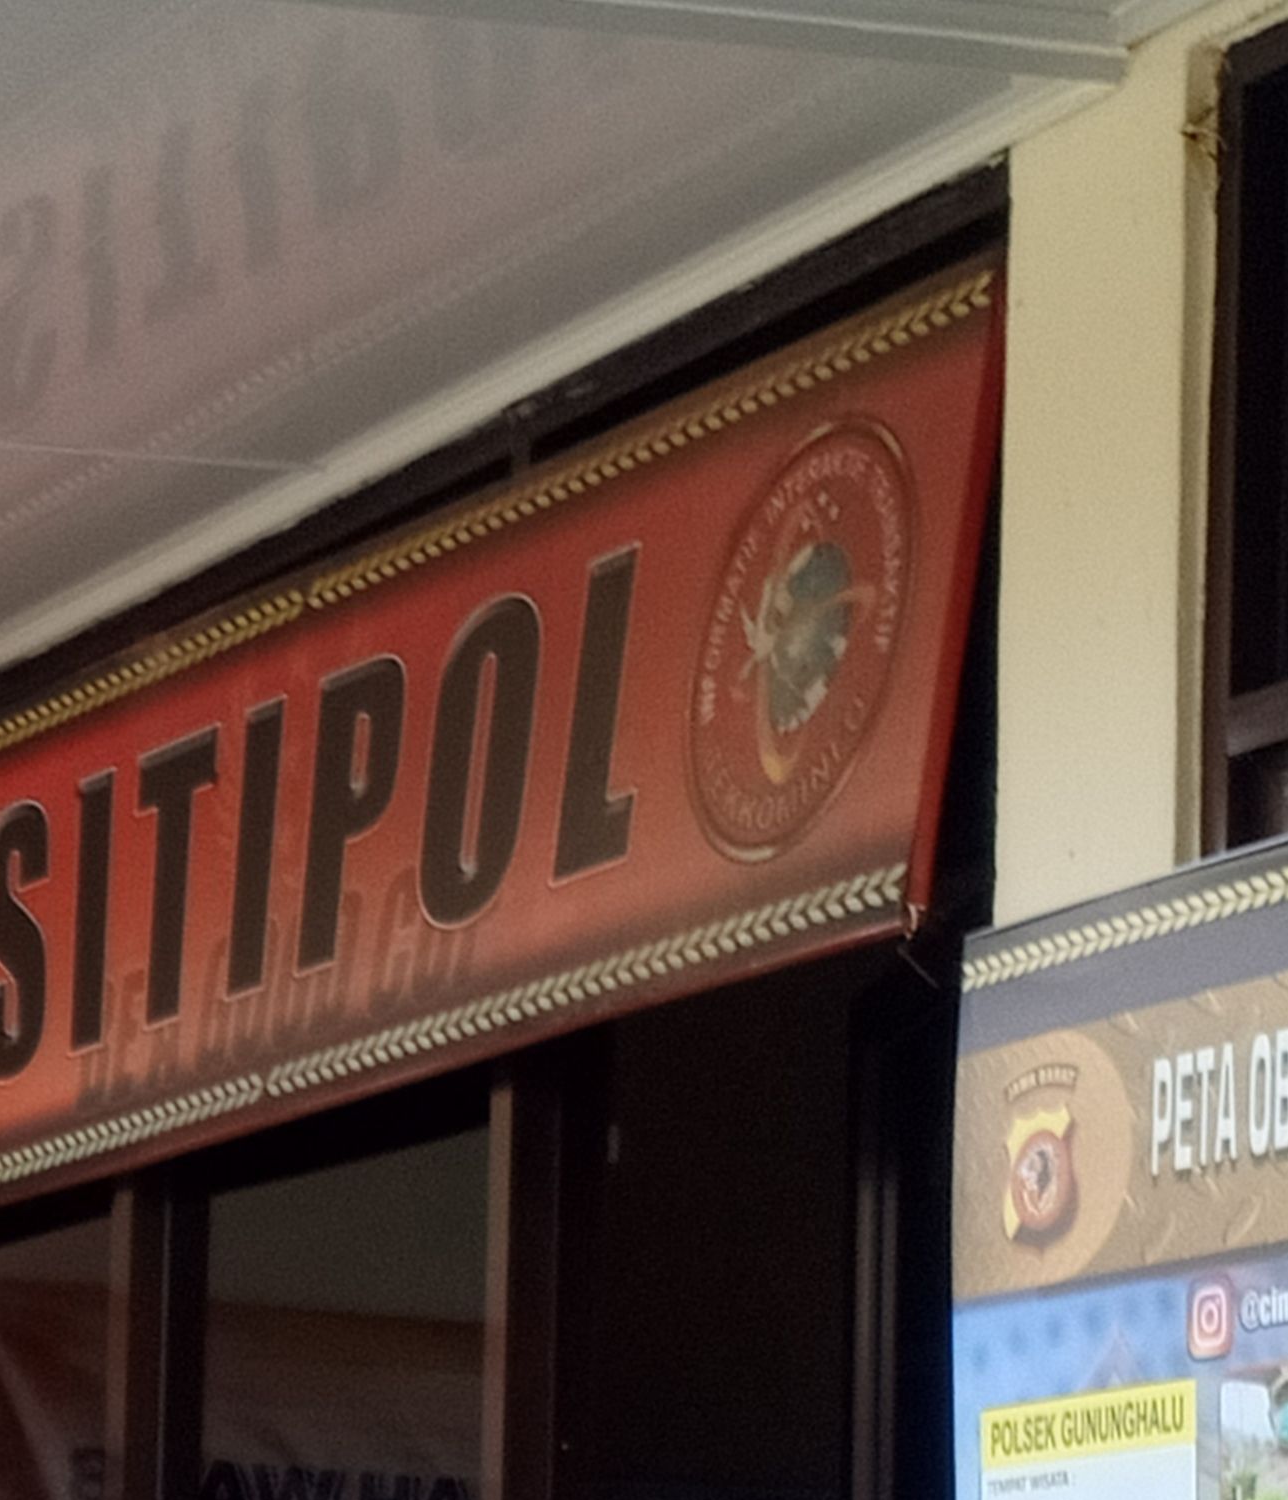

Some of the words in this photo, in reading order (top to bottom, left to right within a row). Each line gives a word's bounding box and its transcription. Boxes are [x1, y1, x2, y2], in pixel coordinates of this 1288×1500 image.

[1151, 1042, 1238, 1176] PETA
[991, 1414, 1058, 1458] POLSEK
[1060, 1395, 1186, 1447] GUNUNGHALU
